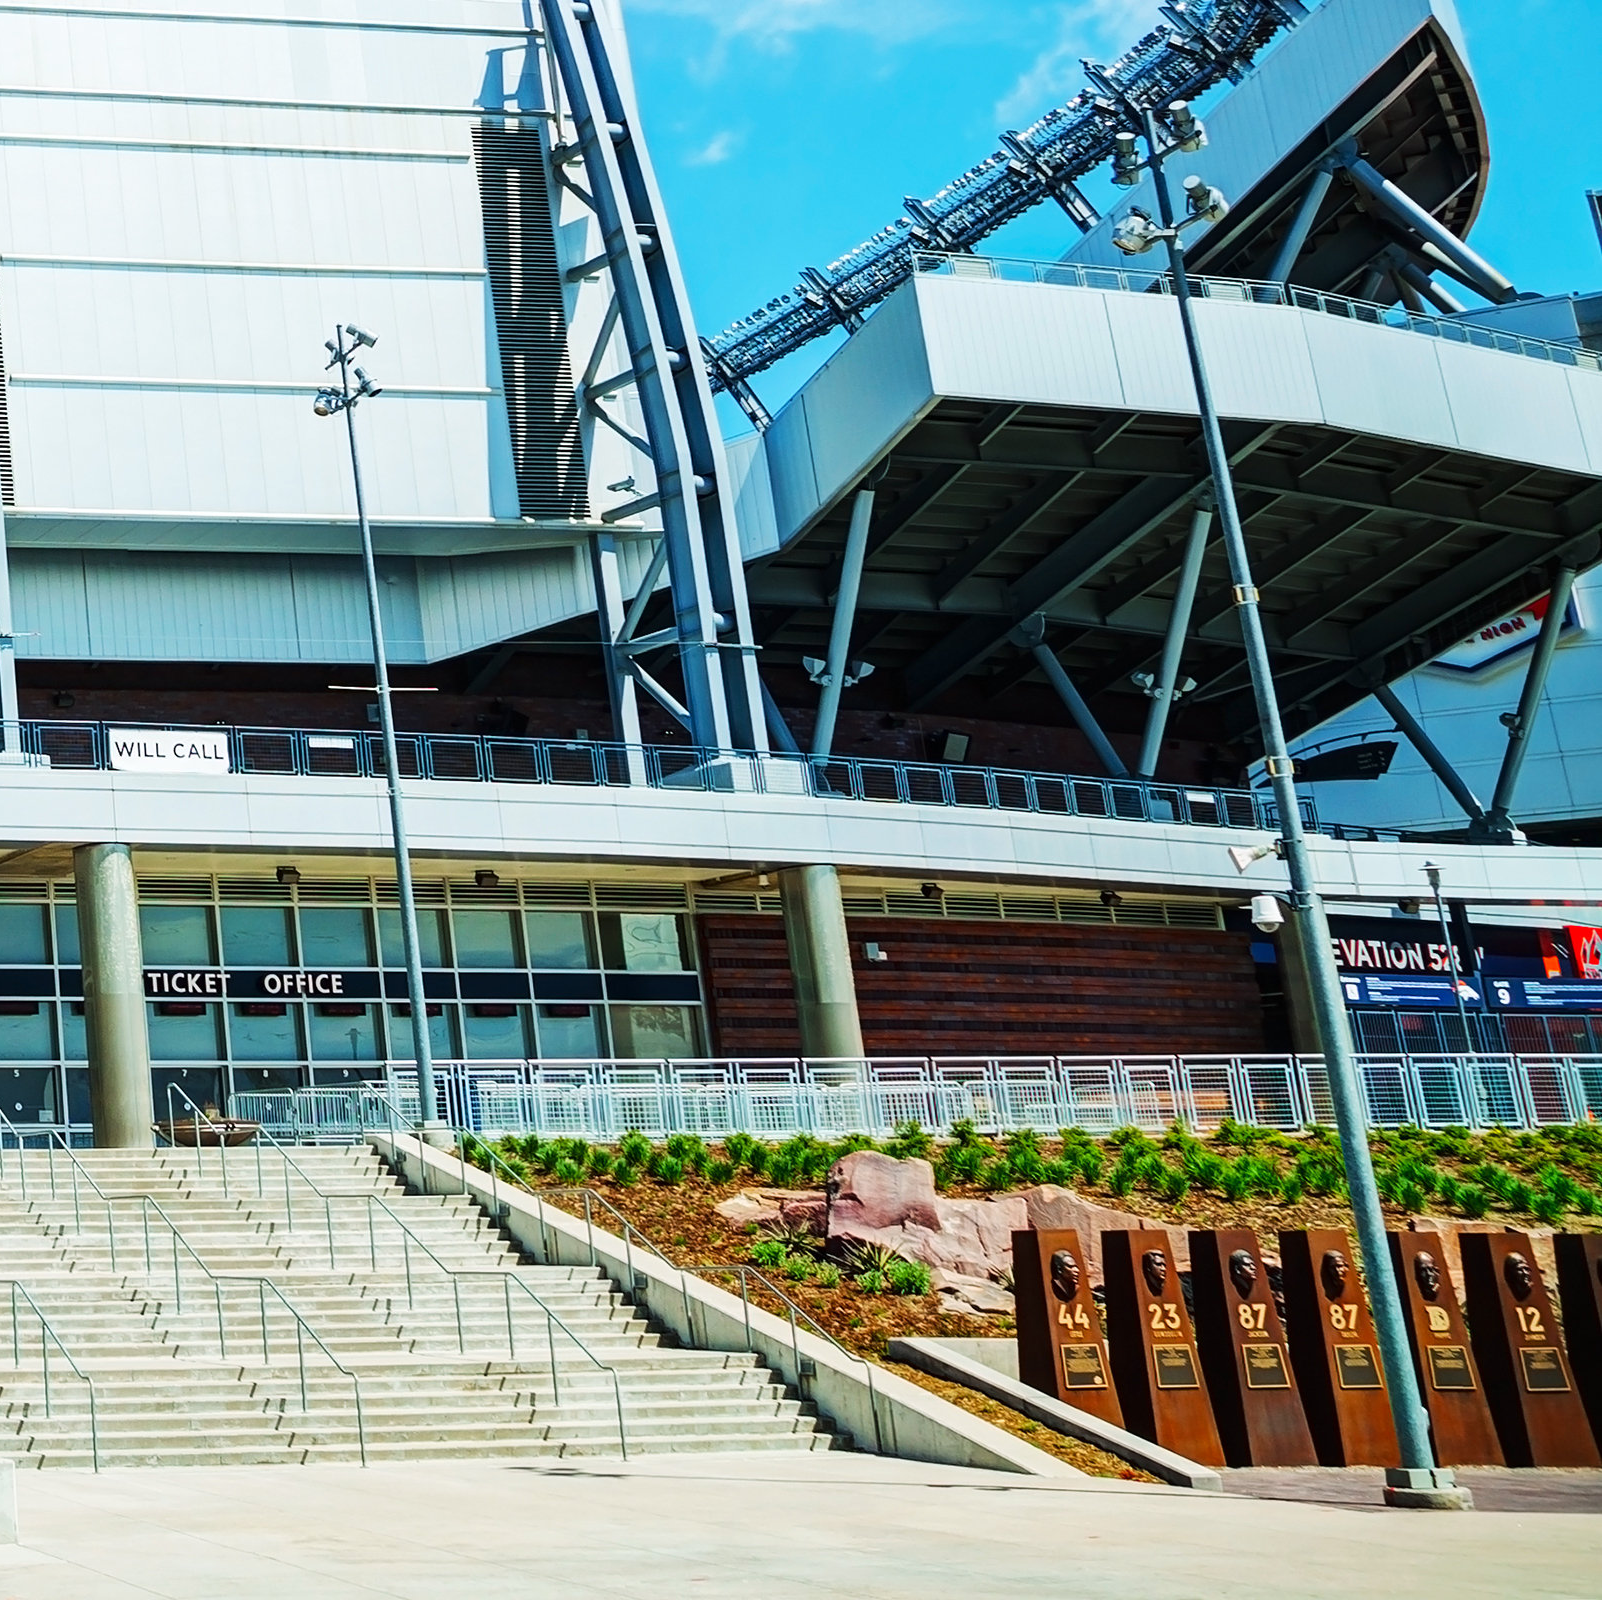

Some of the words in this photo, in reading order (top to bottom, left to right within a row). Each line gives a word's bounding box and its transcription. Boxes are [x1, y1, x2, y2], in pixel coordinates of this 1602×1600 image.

[115, 741, 166, 758] WILL
[173, 743, 224, 760] CALL
[147, 972, 232, 993] TICKET
[263, 973, 344, 994] OFFICE
[1497, 988, 1511, 1005] 9
[13, 1069, 20, 1078] 5
[1058, 1303, 1090, 1330] 44
[1148, 1303, 1181, 1330] 23
[1237, 1303, 1267, 1330] 87
[1329, 1303, 1359, 1330] 87
[1515, 1306, 1545, 1333] 12
